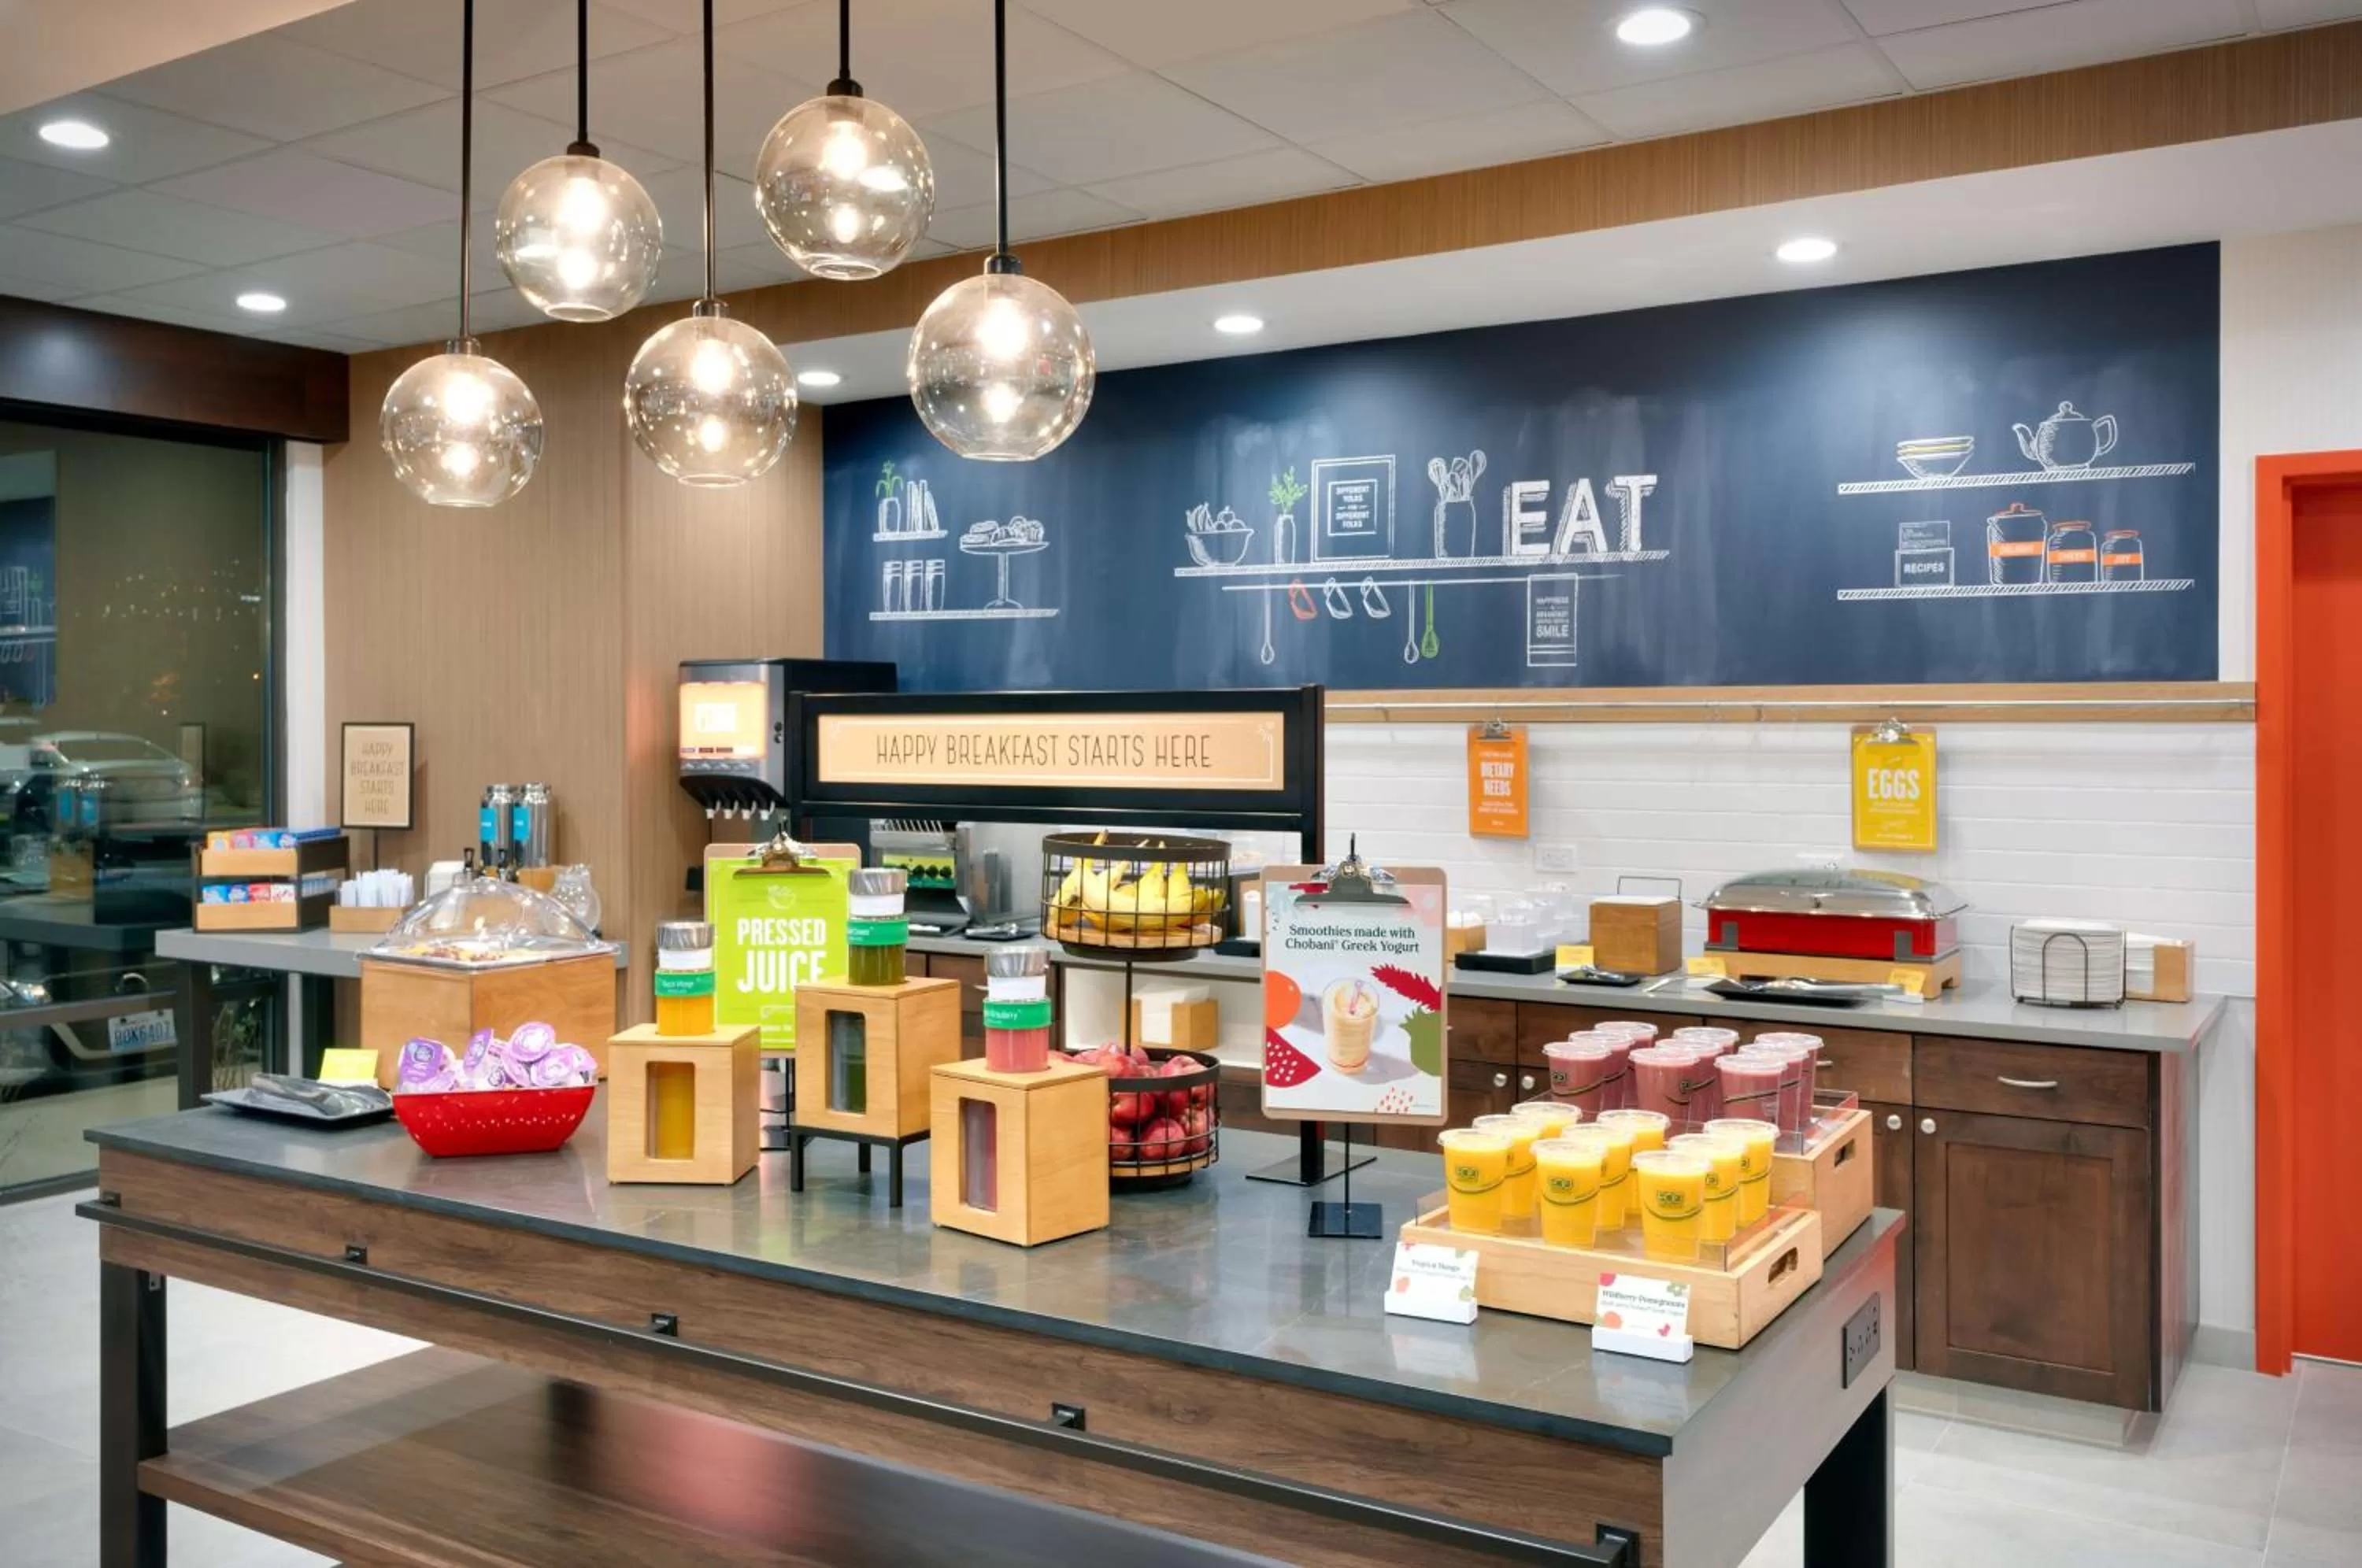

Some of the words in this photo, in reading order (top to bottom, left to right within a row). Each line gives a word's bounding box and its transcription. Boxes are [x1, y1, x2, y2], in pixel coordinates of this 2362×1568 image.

[1503, 475, 1658, 556] EAT
[1903, 562, 1945, 575] RECIPES
[1536, 624, 1569, 638] SMILE
[876, 734, 938, 765] HAPPY
[946, 734, 1059, 767] BREAKFAST
[1068, 734, 1145, 767] STARTS
[1154, 734, 1212, 768] HERE
[1868, 767, 1920, 800] EGGS
[737, 918, 827, 945] PRESSED
[1289, 923, 1352, 937] Smoothies
[1353, 926, 1386, 937] made
[1390, 927, 1416, 939] with
[1341, 939, 1378, 952] Greek
[1380, 940, 1420, 955] Yogurt
[737, 950, 827, 993] JUICE
